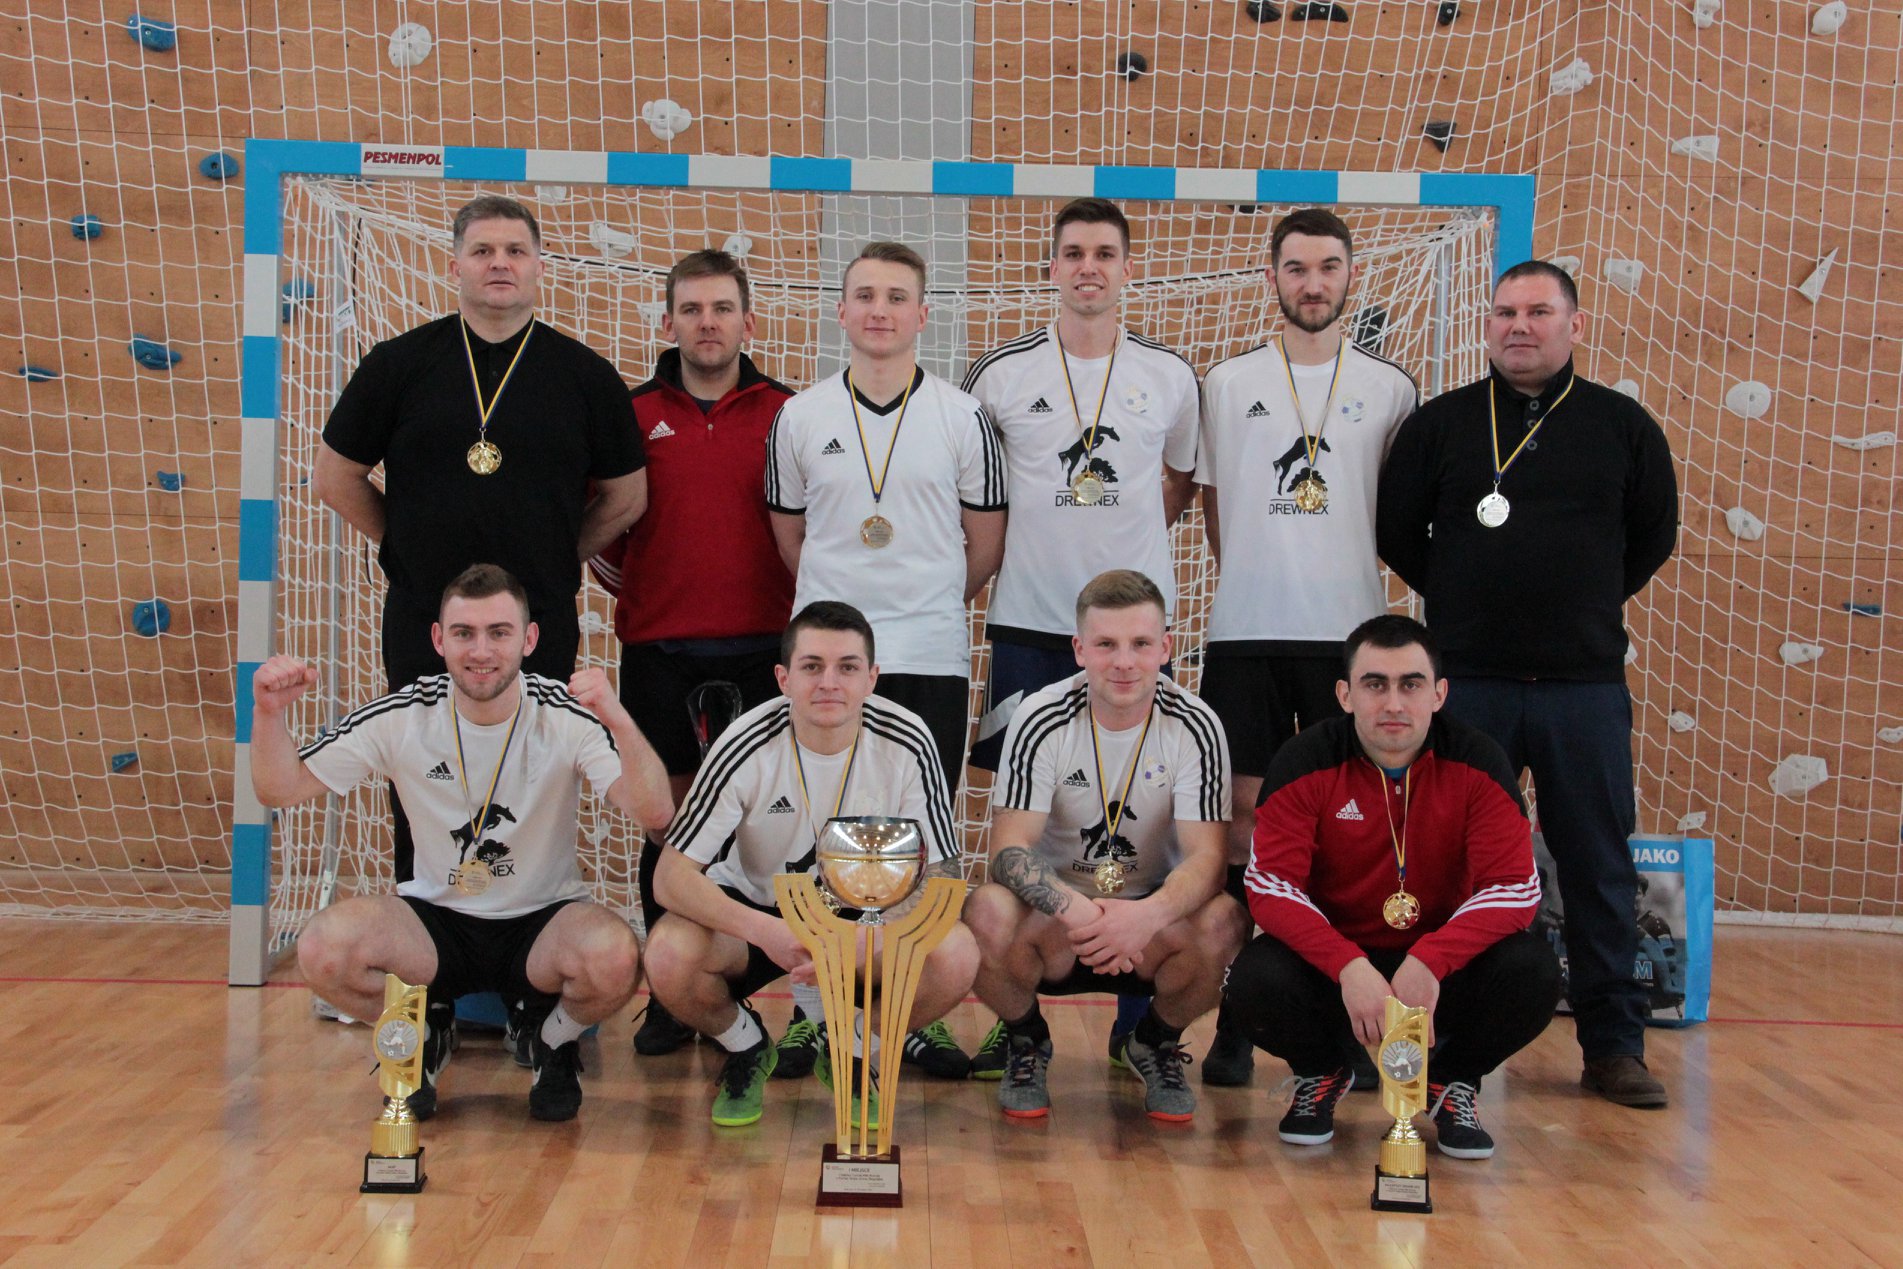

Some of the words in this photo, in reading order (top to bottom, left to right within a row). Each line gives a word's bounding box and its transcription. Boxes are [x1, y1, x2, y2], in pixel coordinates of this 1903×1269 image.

[363, 151, 442, 165] PESMENPOL
[1246, 409, 1270, 418] adidas
[648, 429, 676, 440] adidas
[822, 447, 845, 456] adidas
[426, 772, 455, 781] adidas
[1062, 779, 1090, 788] adidas
[767, 806, 796, 814] adidas
[1335, 811, 1364, 821] adidas
[1633, 848, 1680, 865] JAKO
